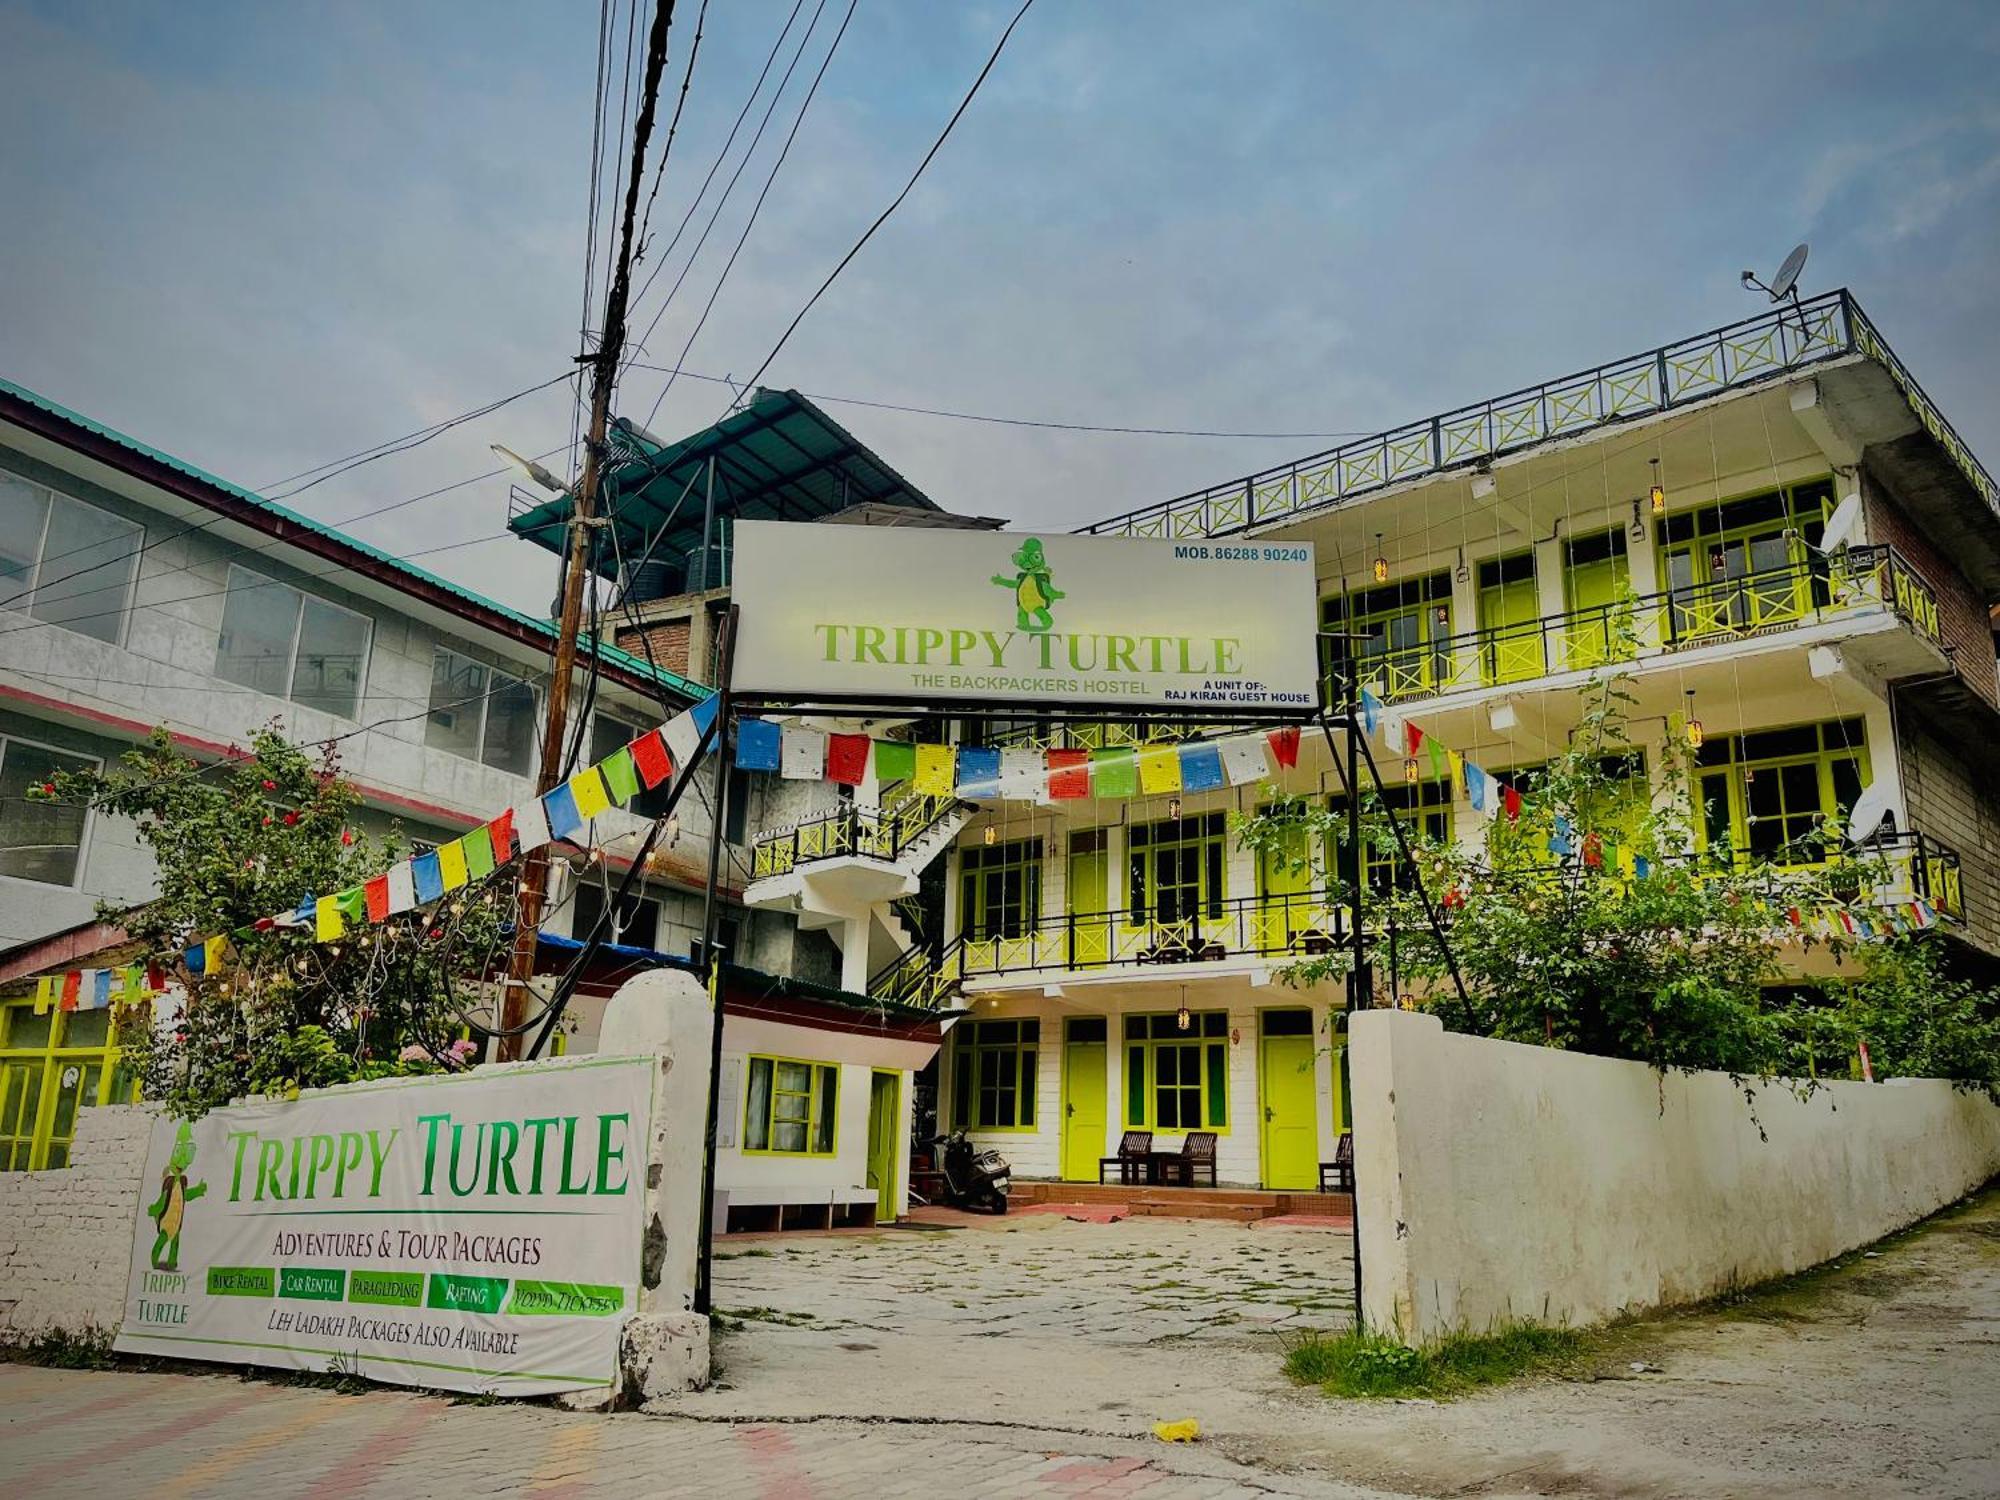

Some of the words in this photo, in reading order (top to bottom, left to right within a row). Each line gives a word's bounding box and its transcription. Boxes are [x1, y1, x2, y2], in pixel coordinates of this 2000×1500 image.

[1174, 546, 1259, 560] MOB.86288
[1263, 548, 1308, 562] 90240
[814, 624, 1017, 668] TRIPPY
[1028, 632, 1243, 674] TURTLE
[911, 674, 945, 688] THE
[950, 675, 1078, 693] BACKPACKERS
[1083, 679, 1151, 695] HOSTEL
[1203, 681, 1212, 690] A
[1215, 681, 1242, 691] UNIT
[1164, 690, 1187, 700] RAJ
[1190, 690, 1227, 701] KIRAN
[1229, 692, 1267, 702] GUEST
[1271, 692, 1311, 703] HOUSE
[226, 1128, 400, 1202] TRIPPY
[416, 1112, 630, 1197] TURTLE
[273, 1230, 374, 1258] ADVENTURES
[378, 1229, 392, 1259] &
[397, 1229, 448, 1260] TOUR
[452, 1231, 542, 1265] PACKAGES
[141, 1270, 191, 1294] TRIPPY
[236, 1274, 269, 1290] RENTAL
[285, 1274, 304, 1292] CAR
[304, 1275, 338, 1293] RENTAL
[351, 1278, 420, 1299] PARAGLIDING
[137, 1299, 190, 1324] TURTLE
[267, 1308, 295, 1332] LEH
[295, 1311, 345, 1337] LADAKH
[347, 1314, 413, 1344] PACKAGES
[412, 1321, 450, 1348] ALSO
